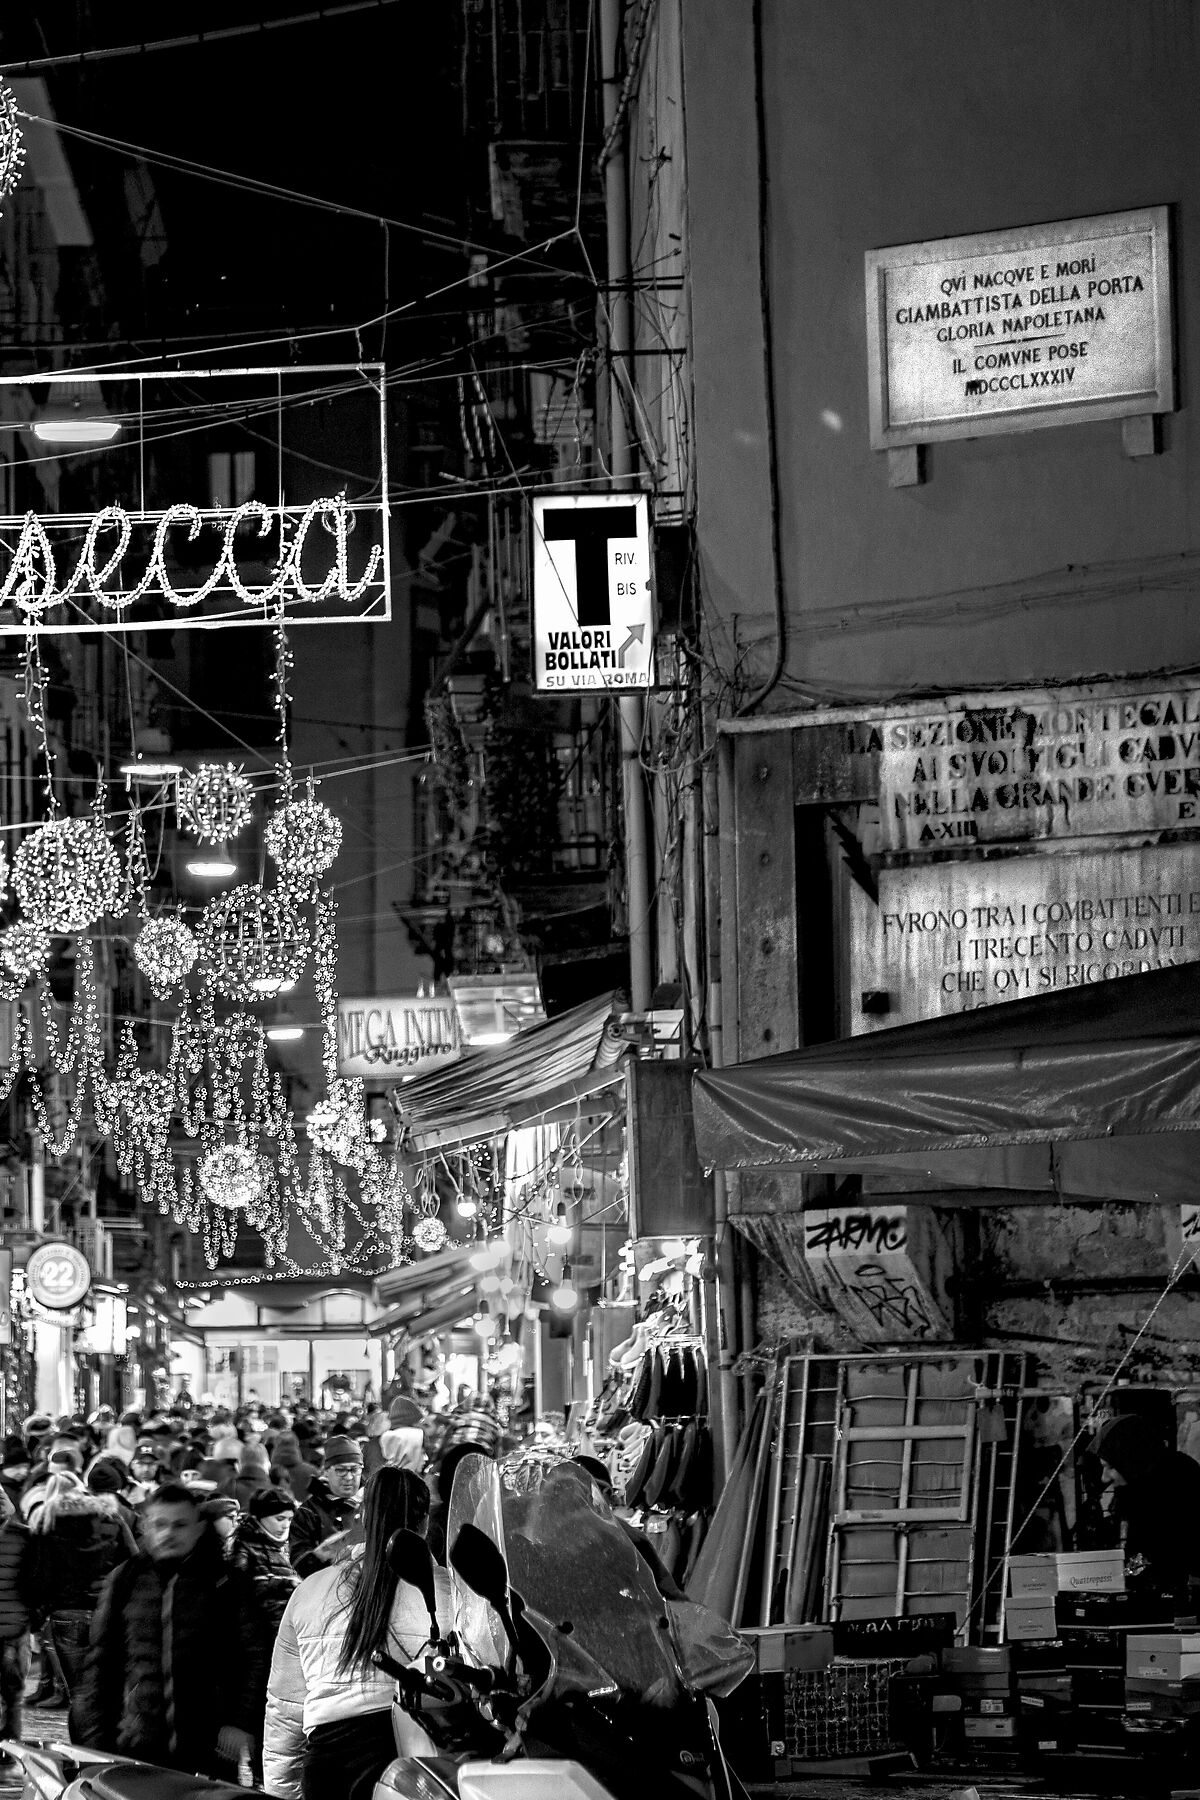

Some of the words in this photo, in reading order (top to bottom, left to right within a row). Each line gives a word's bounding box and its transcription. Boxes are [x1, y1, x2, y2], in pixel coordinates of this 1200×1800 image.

[973, 266, 1035, 290] NACQVE
[1040, 264, 1050, 279] E
[895, 292, 1023, 324] GIAMBATTISTA
[1029, 285, 1081, 307] DELLA
[1088, 275, 1144, 298] PORTA
[936, 321, 996, 343] GLORIA
[1002, 307, 1106, 334] NAPOLETANA
[952, 358, 967, 375] IL
[974, 347, 1042, 371] COMVNE
[1048, 341, 1089, 361] POSE
[617, 582, 637, 596] BIS
[548, 630, 612, 650] VALORI
[545, 650, 617, 671] BOLLATI
[546, 675, 566, 688] SU
[571, 673, 597, 687] VIA
[603, 672, 647, 686] ROMA
[848, 727, 884, 754] LA
[912, 757, 938, 783] AI
[949, 749, 1016, 779] SVOI
[1118, 732, 1200, 764] CADV
[894, 786, 990, 818] NELLA
[882, 908, 968, 935] FVRONO
[971, 905, 1016, 929] TRA
[1033, 892, 1182, 924] COMBATTENTI
[956, 940, 962, 961] I
[968, 931, 1093, 961] TRECENTO
[1102, 925, 1184, 951] CADVTI
[941, 970, 986, 993] CHE
[993, 967, 1030, 994] QVI
[1038, 963, 1057, 988] SI
[363, 1042, 453, 1067] Ruggiero
[40, 1260, 75, 1287] 22
